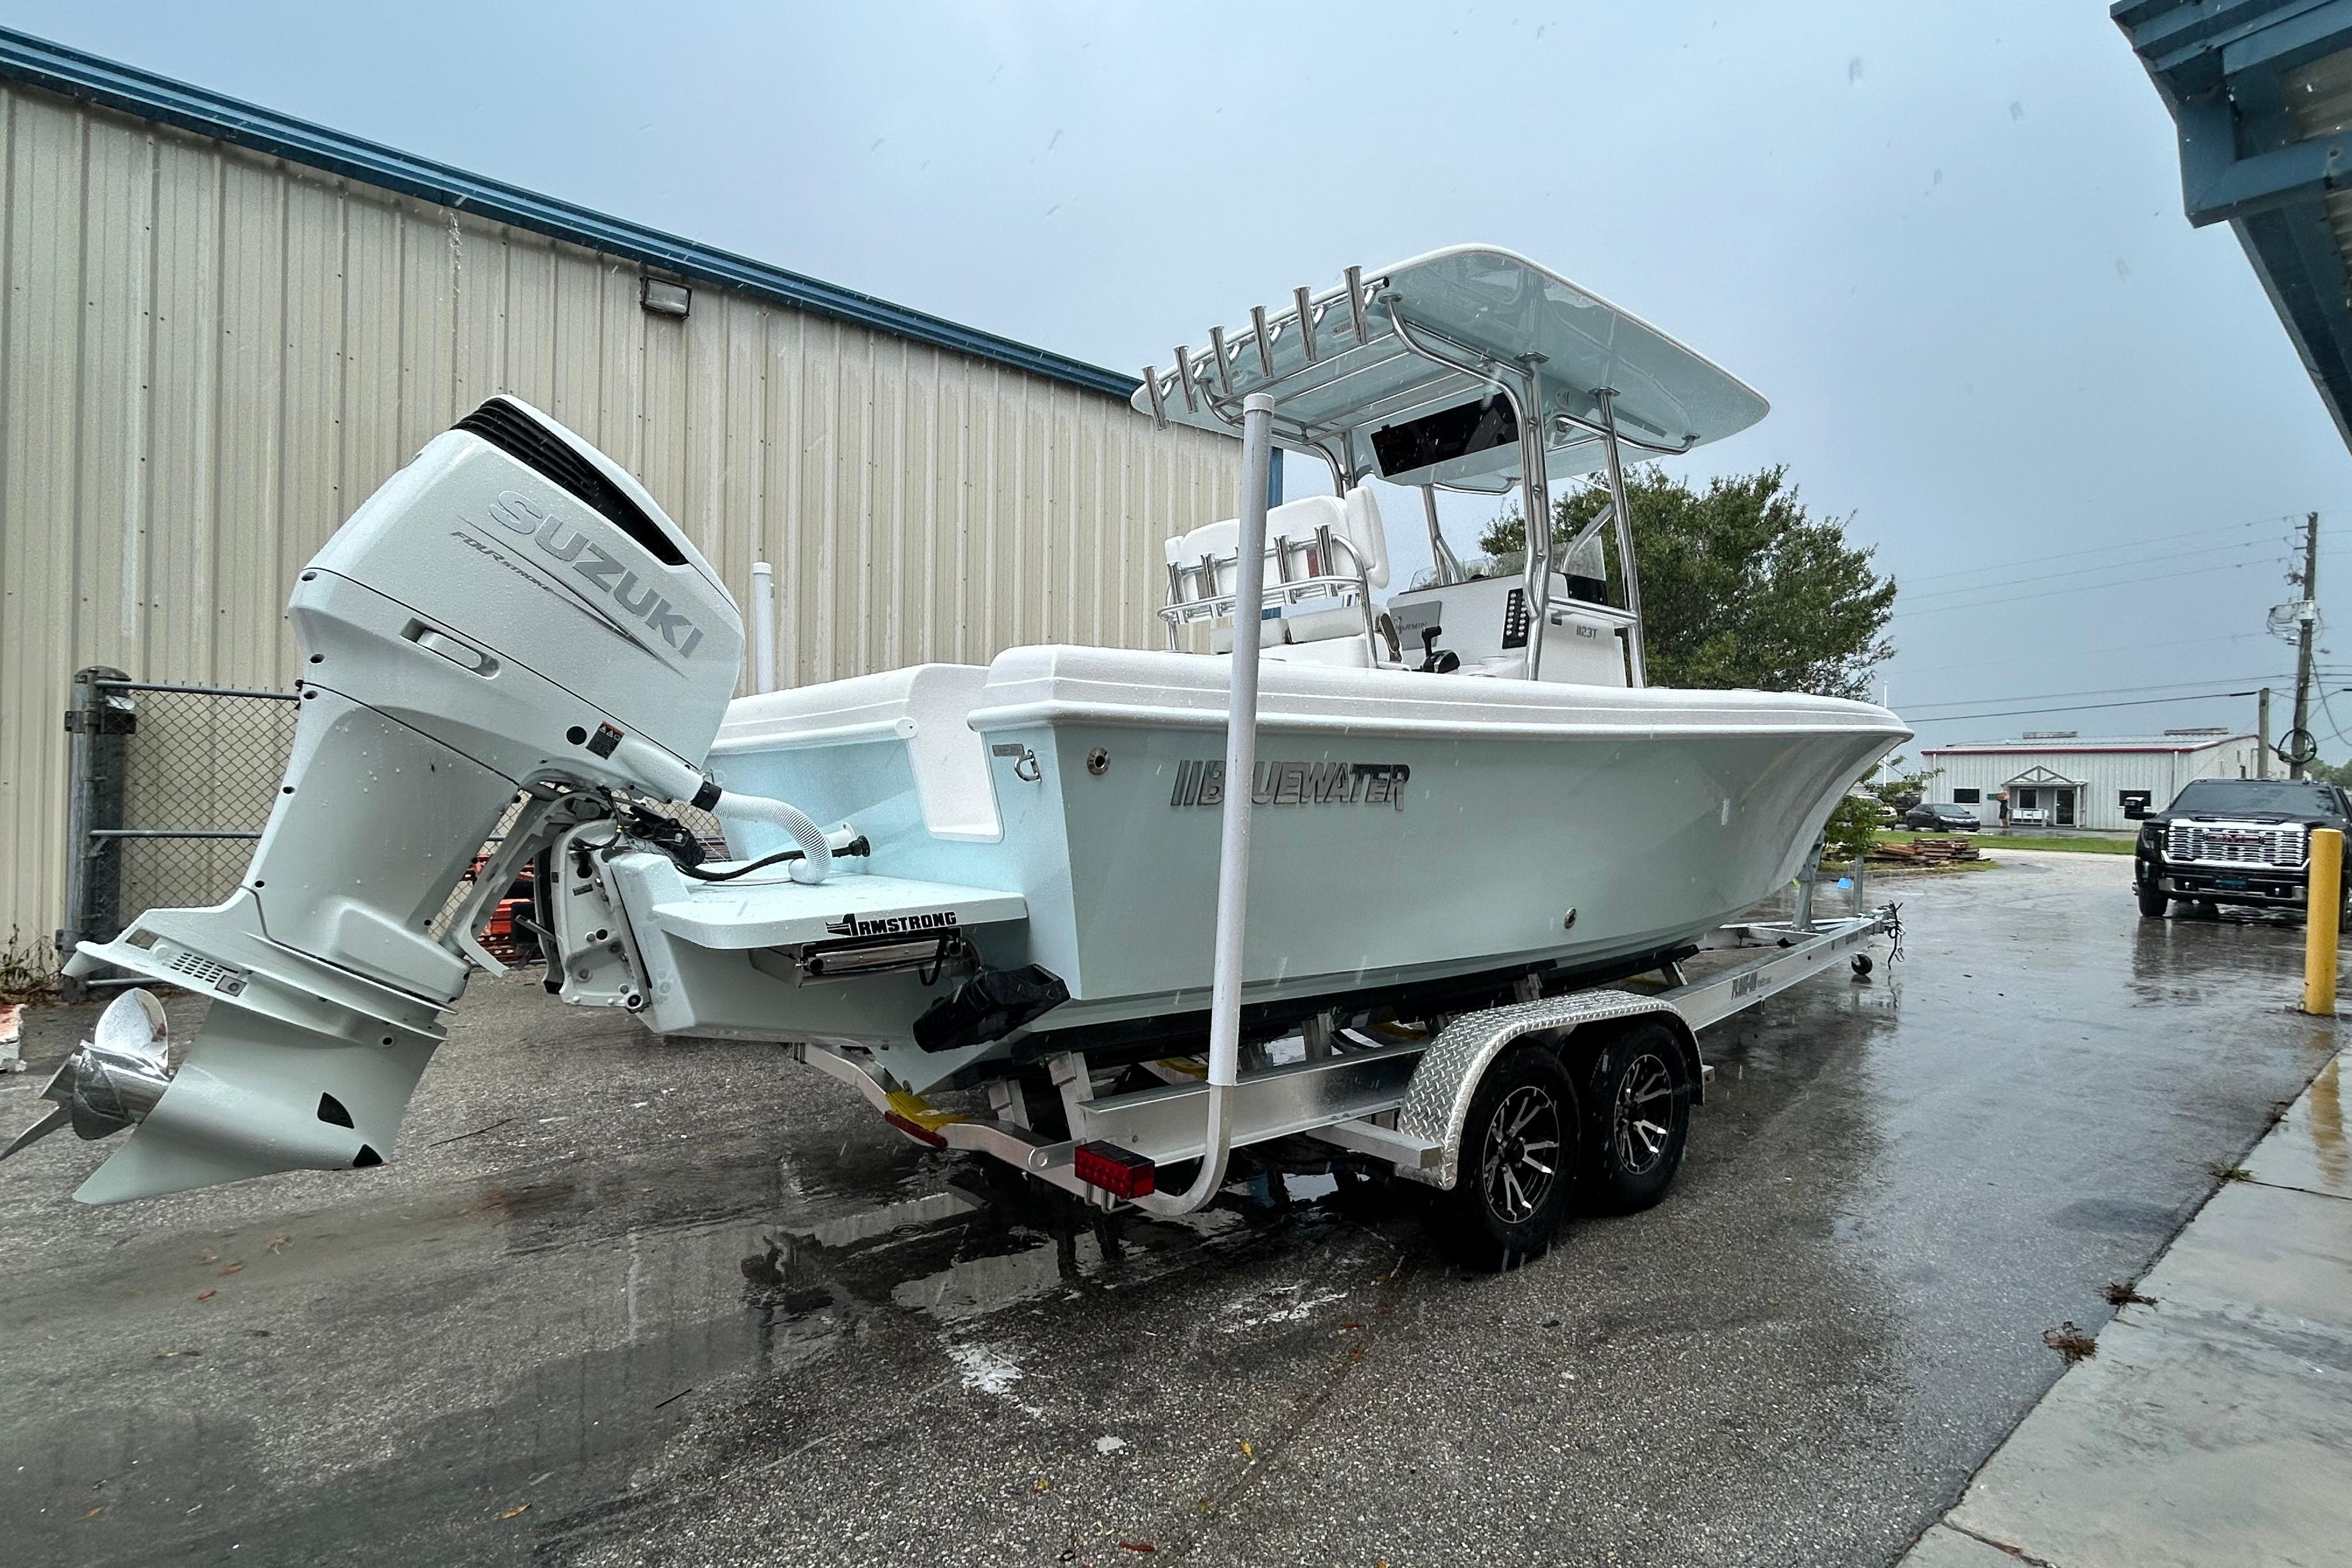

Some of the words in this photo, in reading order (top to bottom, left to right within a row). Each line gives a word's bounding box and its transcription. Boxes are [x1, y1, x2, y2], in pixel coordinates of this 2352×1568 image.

[449, 531, 505, 562] FOUR
[489, 490, 704, 659] SUZUKI
[1197, 760, 1410, 811] BUEWATER
[826, 912, 957, 937] ARMSTRONG
